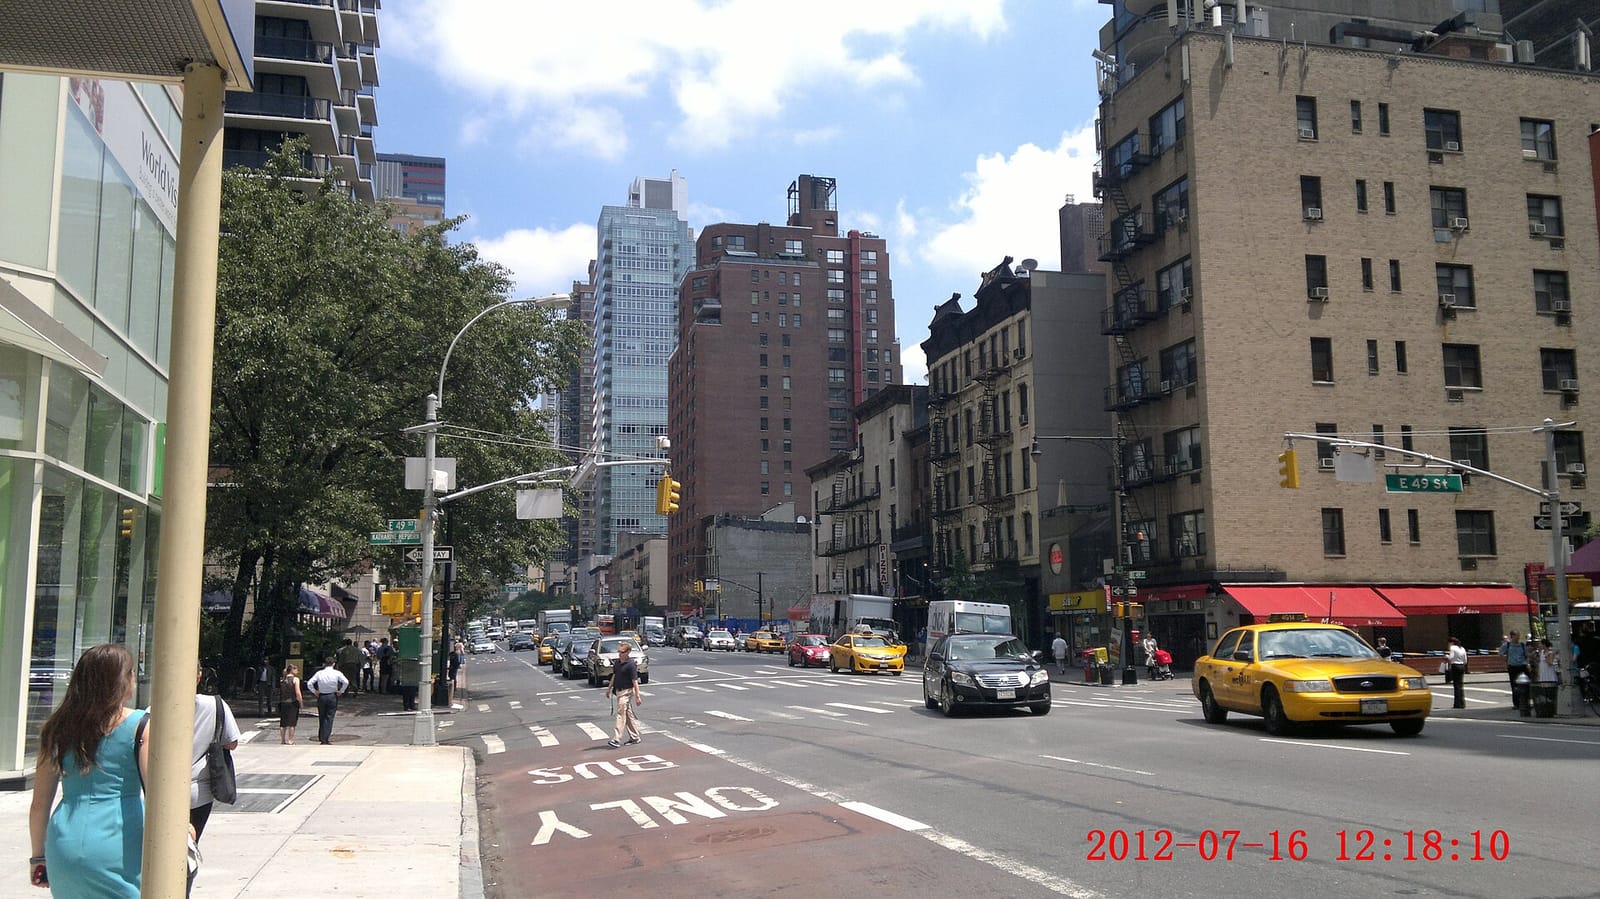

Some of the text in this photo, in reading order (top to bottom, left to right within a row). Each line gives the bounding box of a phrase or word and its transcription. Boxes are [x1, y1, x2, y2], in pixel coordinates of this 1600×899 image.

[142, 131, 166, 192] World
[167, 170, 178, 208] Vis
[1400, 478, 1449, 490] E 49 St
[389, 521, 394, 530] E
[396, 521, 406, 530] 49
[880, 545, 888, 582] PIZZA
[528, 754, 680, 785] BUS
[531, 786, 780, 846] ONLY
